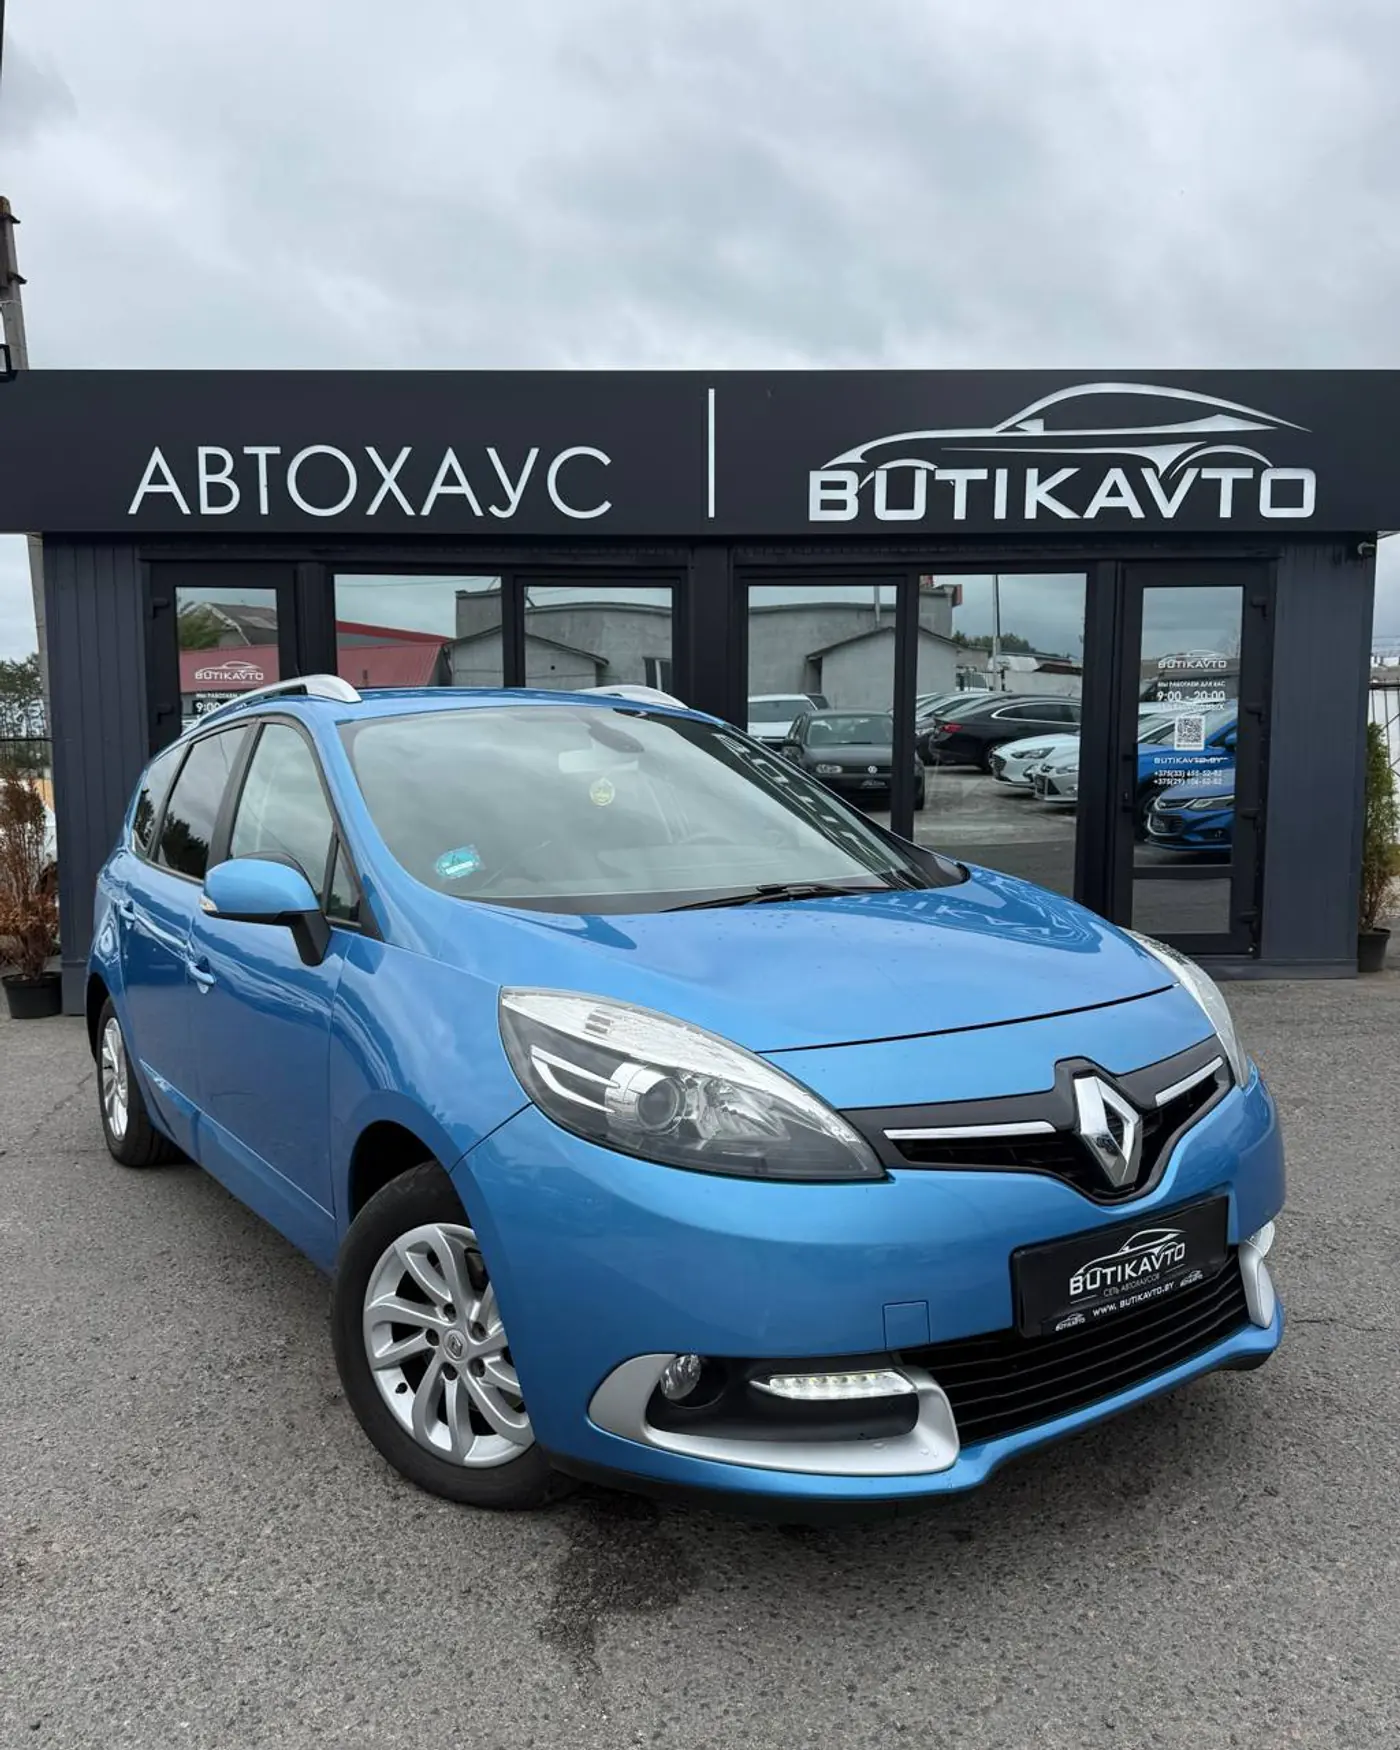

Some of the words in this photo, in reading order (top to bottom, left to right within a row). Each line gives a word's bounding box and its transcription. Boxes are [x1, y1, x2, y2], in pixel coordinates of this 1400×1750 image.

[127, 444, 613, 520] АВТОХАУС
[808, 466, 1317, 522] BUTIKAVTO
[195, 671, 264, 681] BUTIKAVTO
[1158, 660, 1227, 669] BUTIKAVTO
[1157, 691, 1182, 702] 9:00
[1194, 691, 1226, 702] 20:00
[1069, 1242, 1186, 1296] BUTIKAVTO
